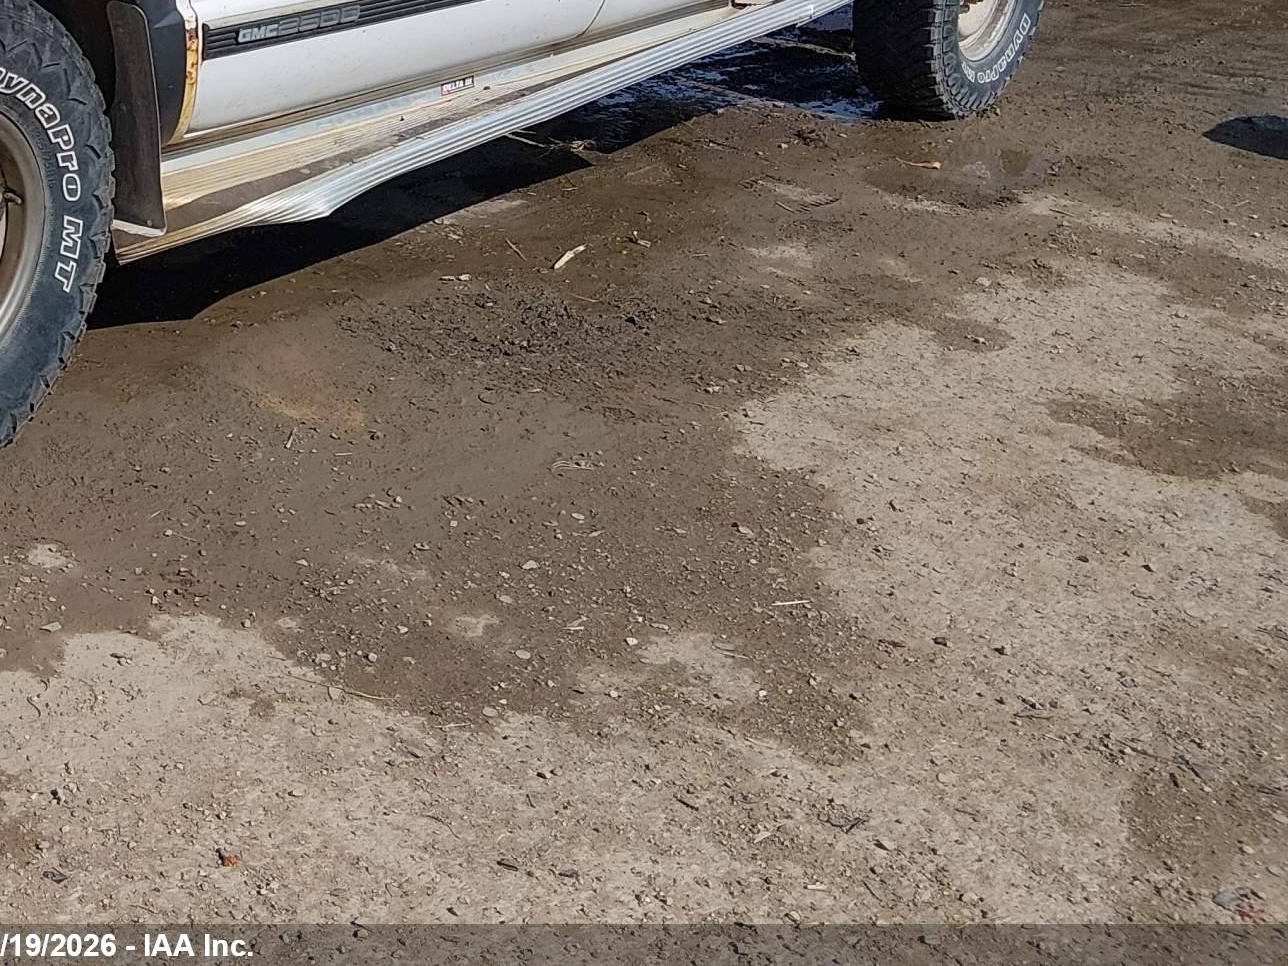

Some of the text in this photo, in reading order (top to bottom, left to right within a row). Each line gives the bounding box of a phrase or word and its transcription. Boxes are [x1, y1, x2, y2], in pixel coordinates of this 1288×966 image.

[238, 4, 361, 43] GMC 2500
[54, 215, 84, 294] MT
